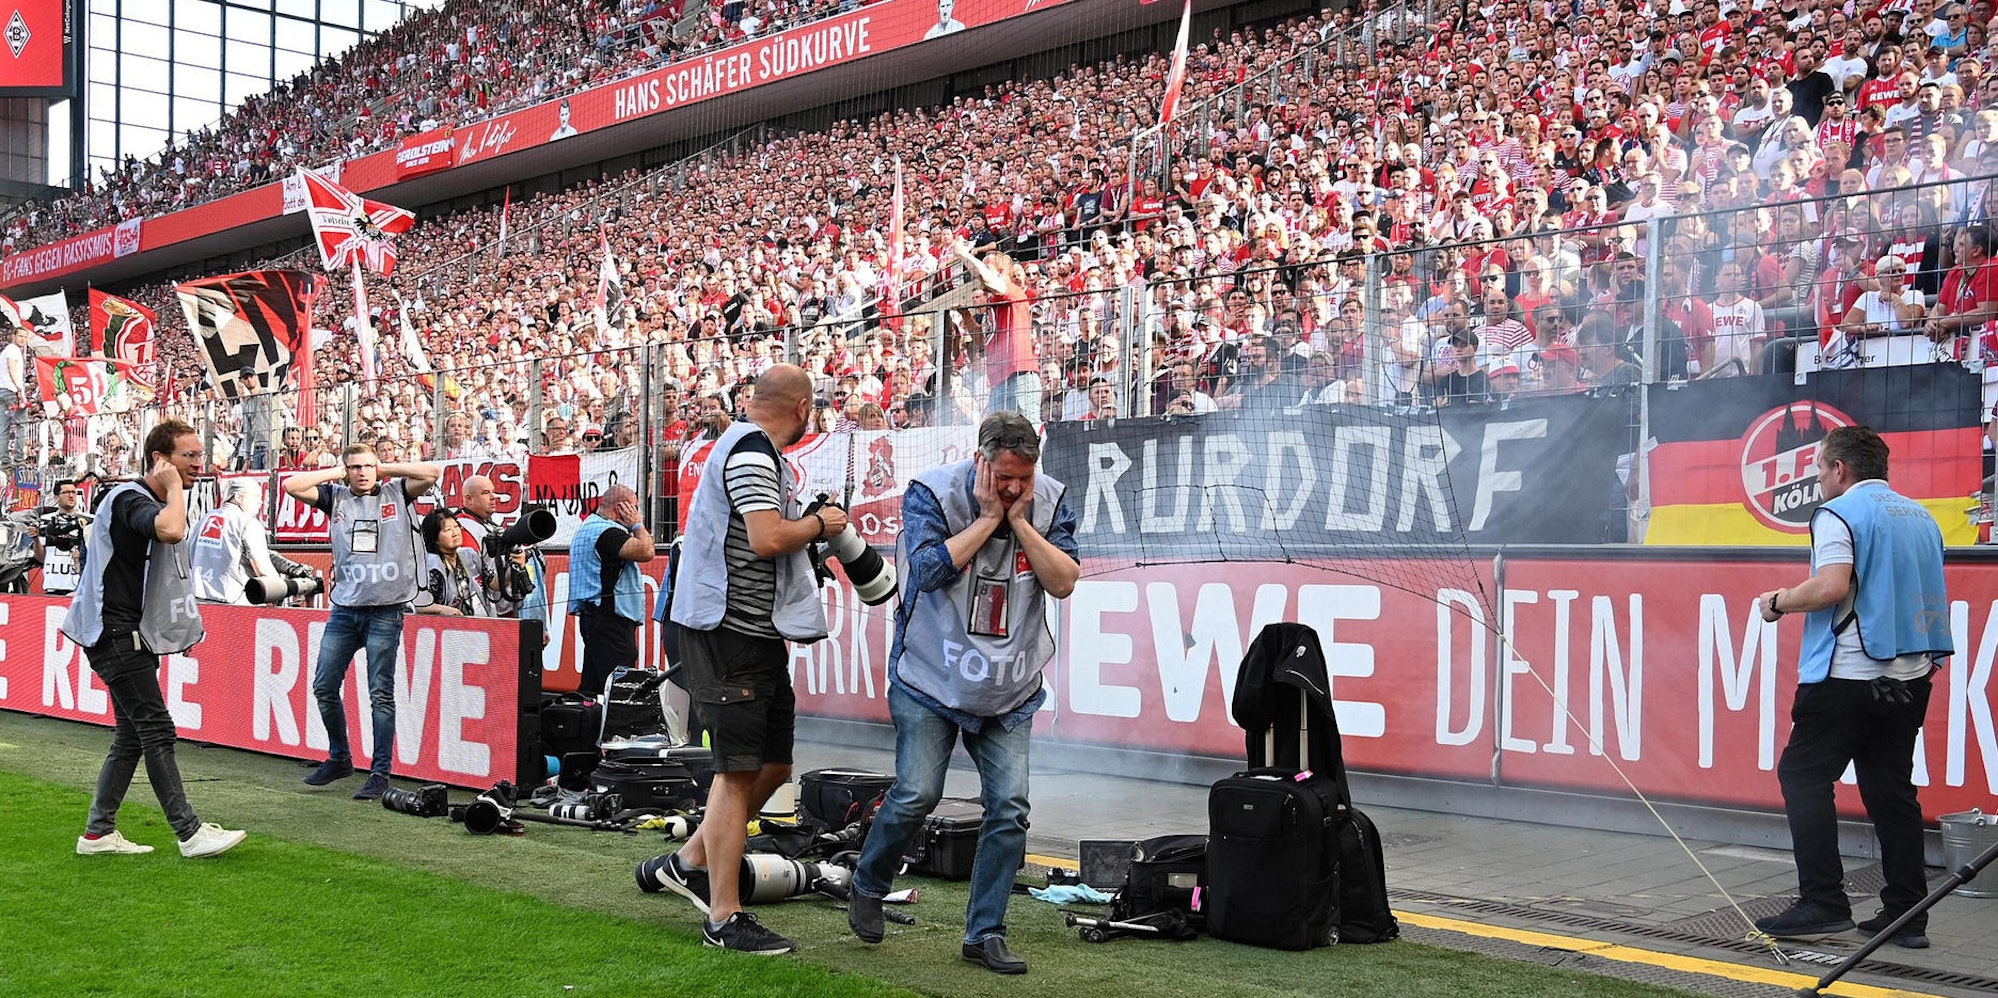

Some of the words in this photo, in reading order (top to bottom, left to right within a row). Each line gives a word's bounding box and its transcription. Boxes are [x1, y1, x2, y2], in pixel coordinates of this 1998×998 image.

[615, 78, 660, 120] HANS
[666, 52, 751, 105] SCHÄFER
[759, 16, 871, 80] SÜDKURVE
[1869, 91, 1900, 102] REWE
[3, 254, 34, 282] FC-FANS
[34, 243, 62, 274] GEGEN
[63, 231, 113, 267] RASSISMUS
[1715, 316, 1744, 327] EWE
[1079, 418, 1548, 534] RURDORF
[1762, 447, 1816, 489] 1.F
[536, 484, 558, 516] NA
[564, 482, 599, 515] UND
[341, 561, 399, 583] FOTO
[943, 639, 1027, 686] FOTO
[1436, 588, 1643, 762] DEIN
[1698, 593, 1998, 795] MK
